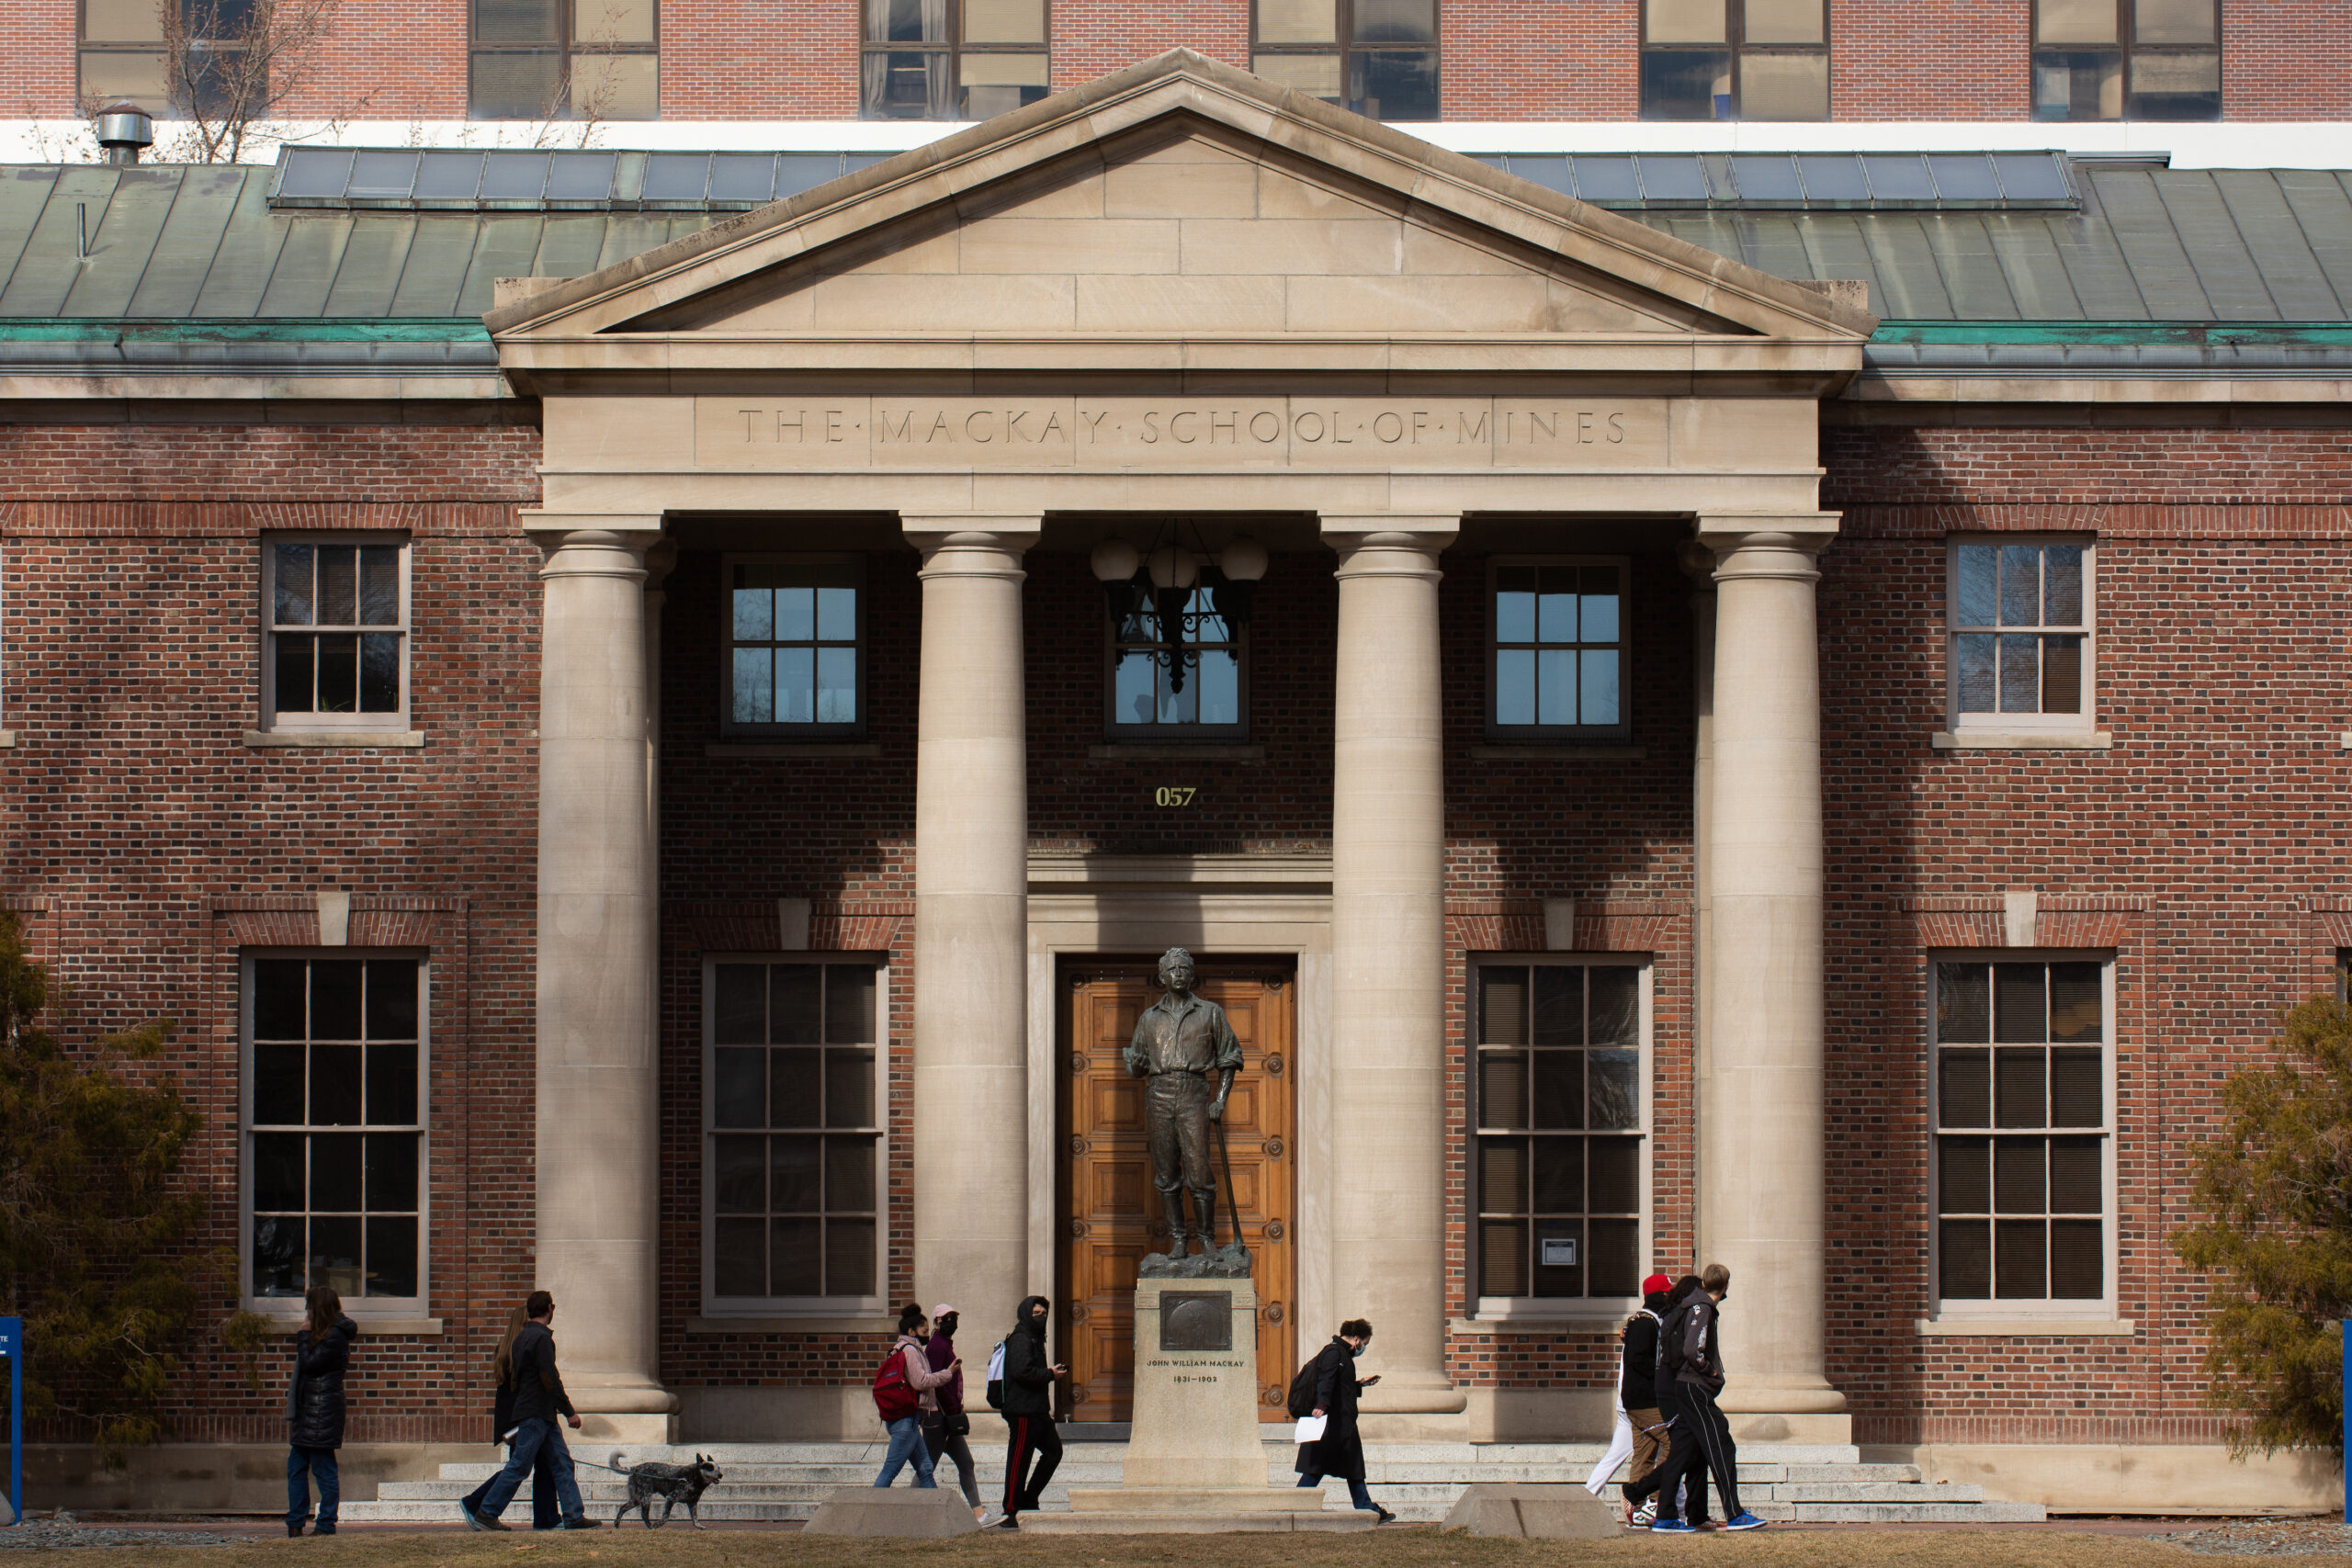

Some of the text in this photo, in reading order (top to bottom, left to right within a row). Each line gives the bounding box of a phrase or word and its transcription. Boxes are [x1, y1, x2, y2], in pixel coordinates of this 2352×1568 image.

[739, 411, 1625, 445] THE MACKAY SCHOOL OF MINES
[1156, 786, 1196, 807] 057
